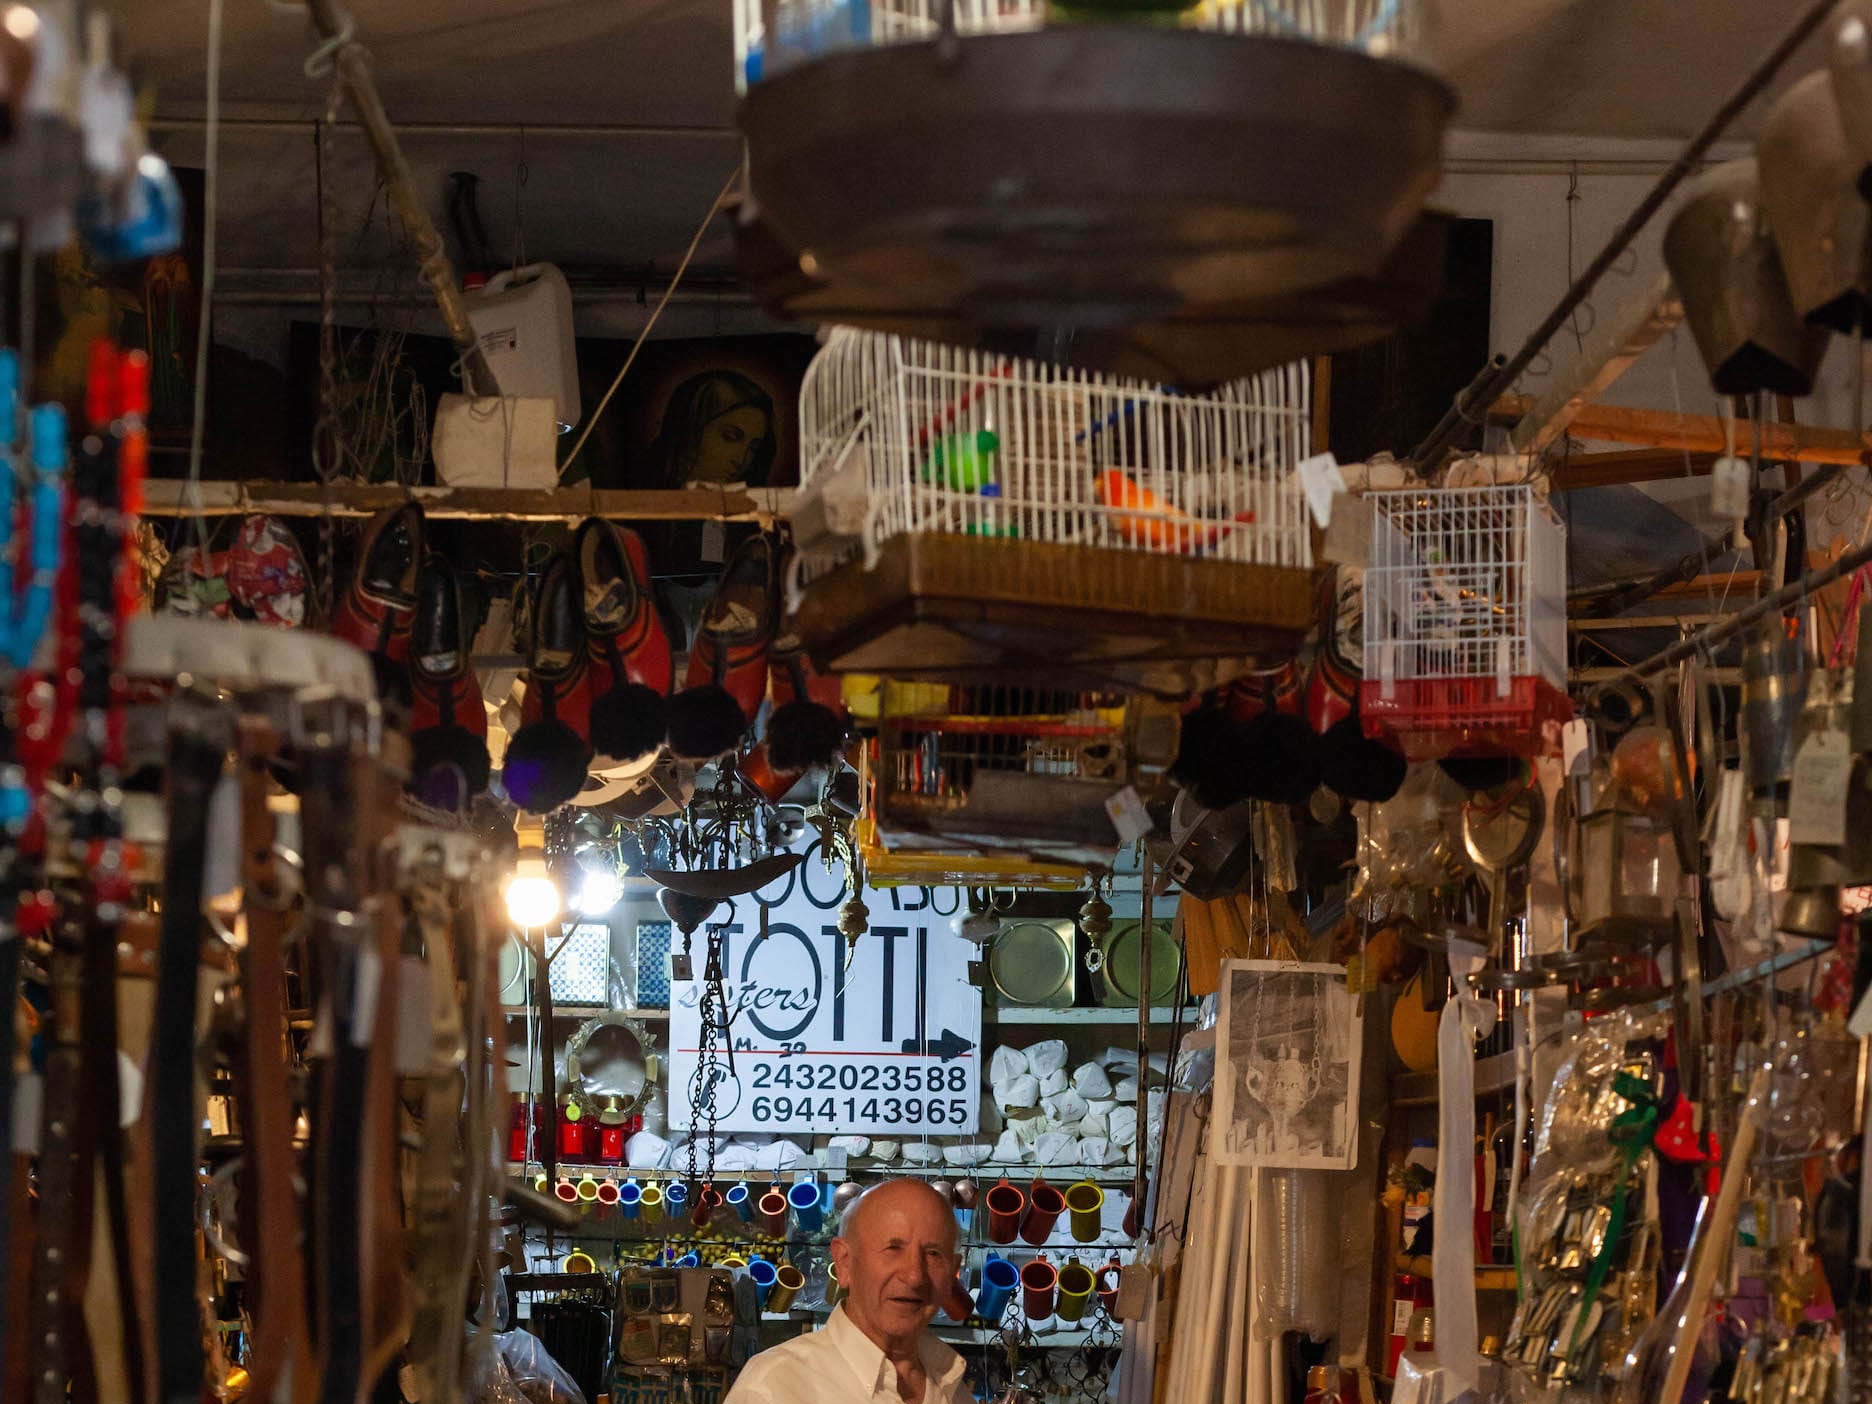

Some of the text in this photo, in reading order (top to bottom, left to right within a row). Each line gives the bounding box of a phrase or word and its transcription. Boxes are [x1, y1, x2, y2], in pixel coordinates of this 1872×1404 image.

[705, 922, 928, 1042] TOTTI
[752, 1063, 967, 1092] 2432023588
[752, 1097, 968, 1124] 6944143965
